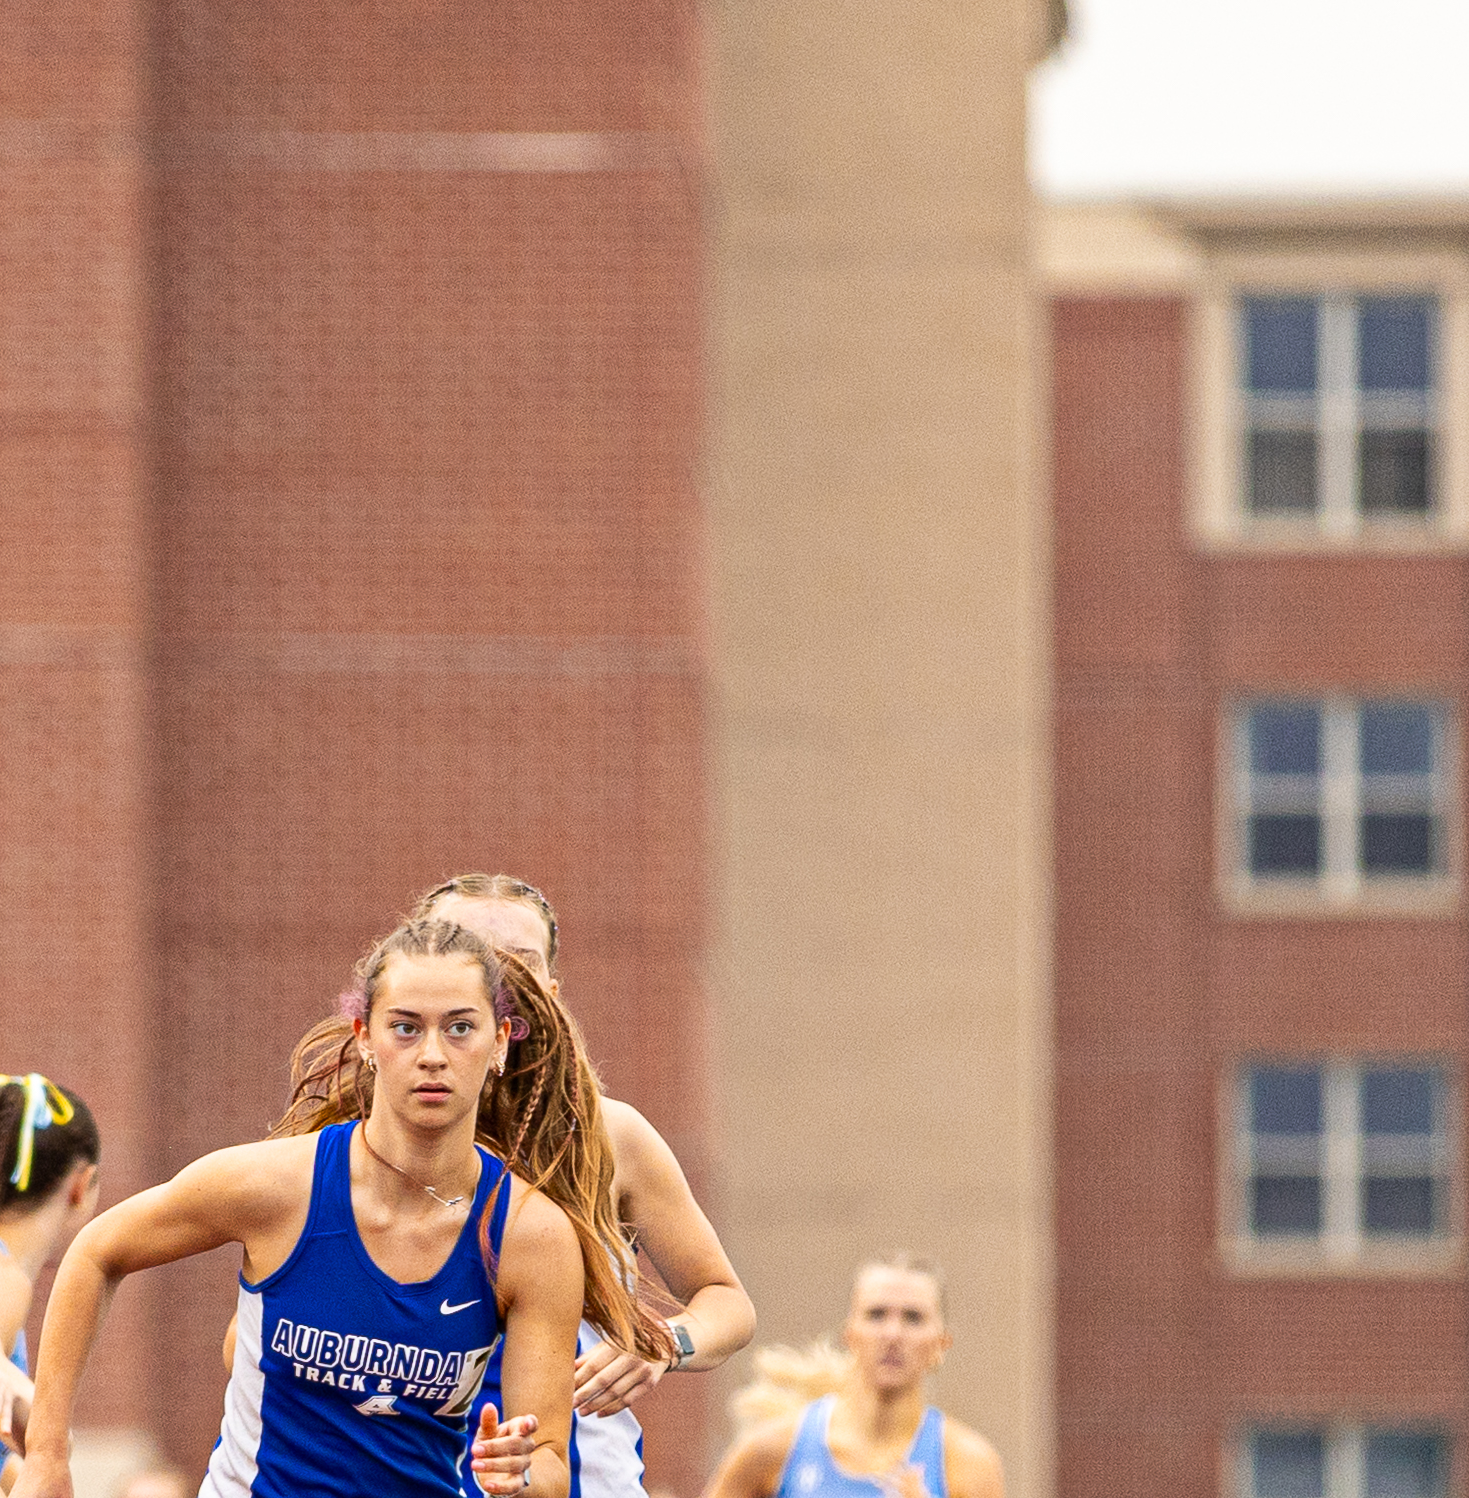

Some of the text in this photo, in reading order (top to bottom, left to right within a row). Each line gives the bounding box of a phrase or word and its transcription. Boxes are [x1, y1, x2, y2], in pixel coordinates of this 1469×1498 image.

[271, 1318, 463, 1386] AUBURNDA
[293, 1362, 366, 1393] TRACK
[377, 1378, 393, 1393] &
